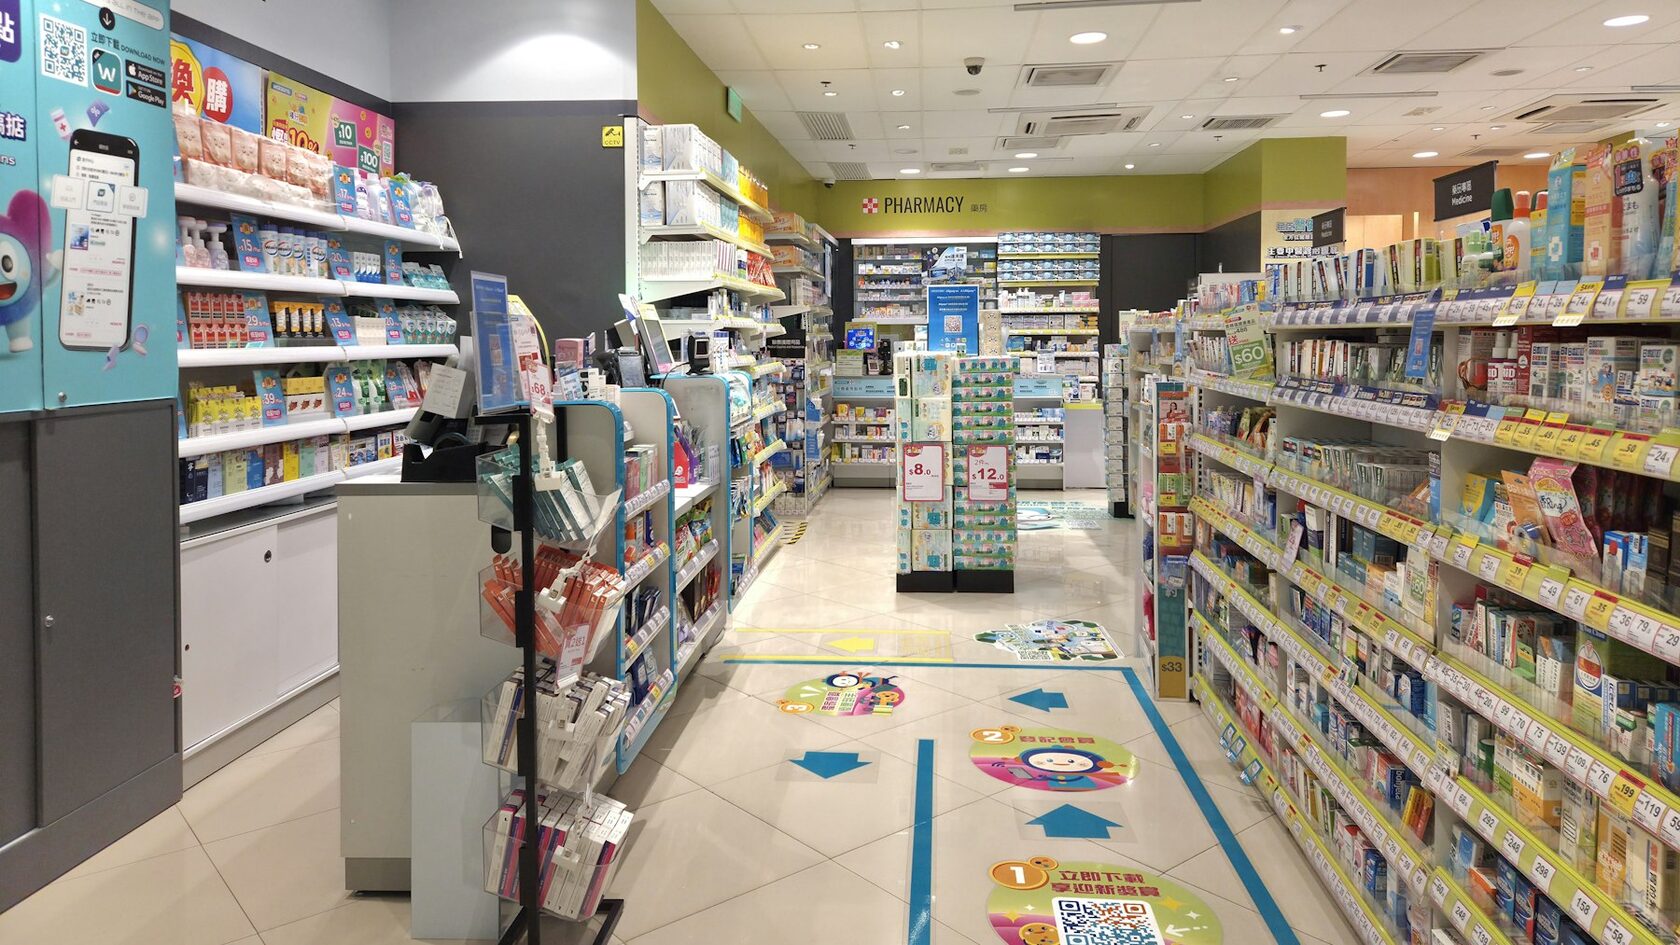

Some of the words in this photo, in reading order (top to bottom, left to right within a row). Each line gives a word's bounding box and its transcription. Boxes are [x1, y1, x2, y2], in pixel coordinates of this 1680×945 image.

[121, 45, 151, 60] DOWNLOAD
[153, 56, 165, 65] NOW
[98, 63, 116, 82] W
[138, 71, 149, 81] App
[149, 75, 163, 85] Store
[138, 91, 154, 102] Google
[155, 96, 164, 106] Play
[206, 78, 228, 113] 購
[338, 123, 352, 139] $10
[360, 151, 378, 168] $100
[884, 197, 964, 213] PHARMACY
[1452, 195, 1472, 206] Medicine
[1234, 346, 1264, 364] $60
[909, 463, 931, 476] $8.0
[972, 468, 1004, 480] $12.0
[1620, 615, 1631, 626] 36
[1666, 633, 1680, 647] 29
[1161, 662, 1182, 672] $33
[1516, 717, 1526, 728] 70
[983, 731, 1002, 742] 2
[1534, 726, 1545, 739] 75
[1554, 741, 1567, 756] 139
[1597, 771, 1610, 784] 76
[1621, 784, 1635, 798] 199
[1644, 800, 1661, 818] 119
[1483, 814, 1495, 828] 292
[1508, 840, 1521, 853] 248
[1010, 866, 1025, 884] 1
[1060, 870, 1145, 884] 立即下載
[1535, 862, 1549, 879] 298
[1051, 882, 1160, 897] 享迎新獎賞
[1577, 897, 1591, 915] 158
